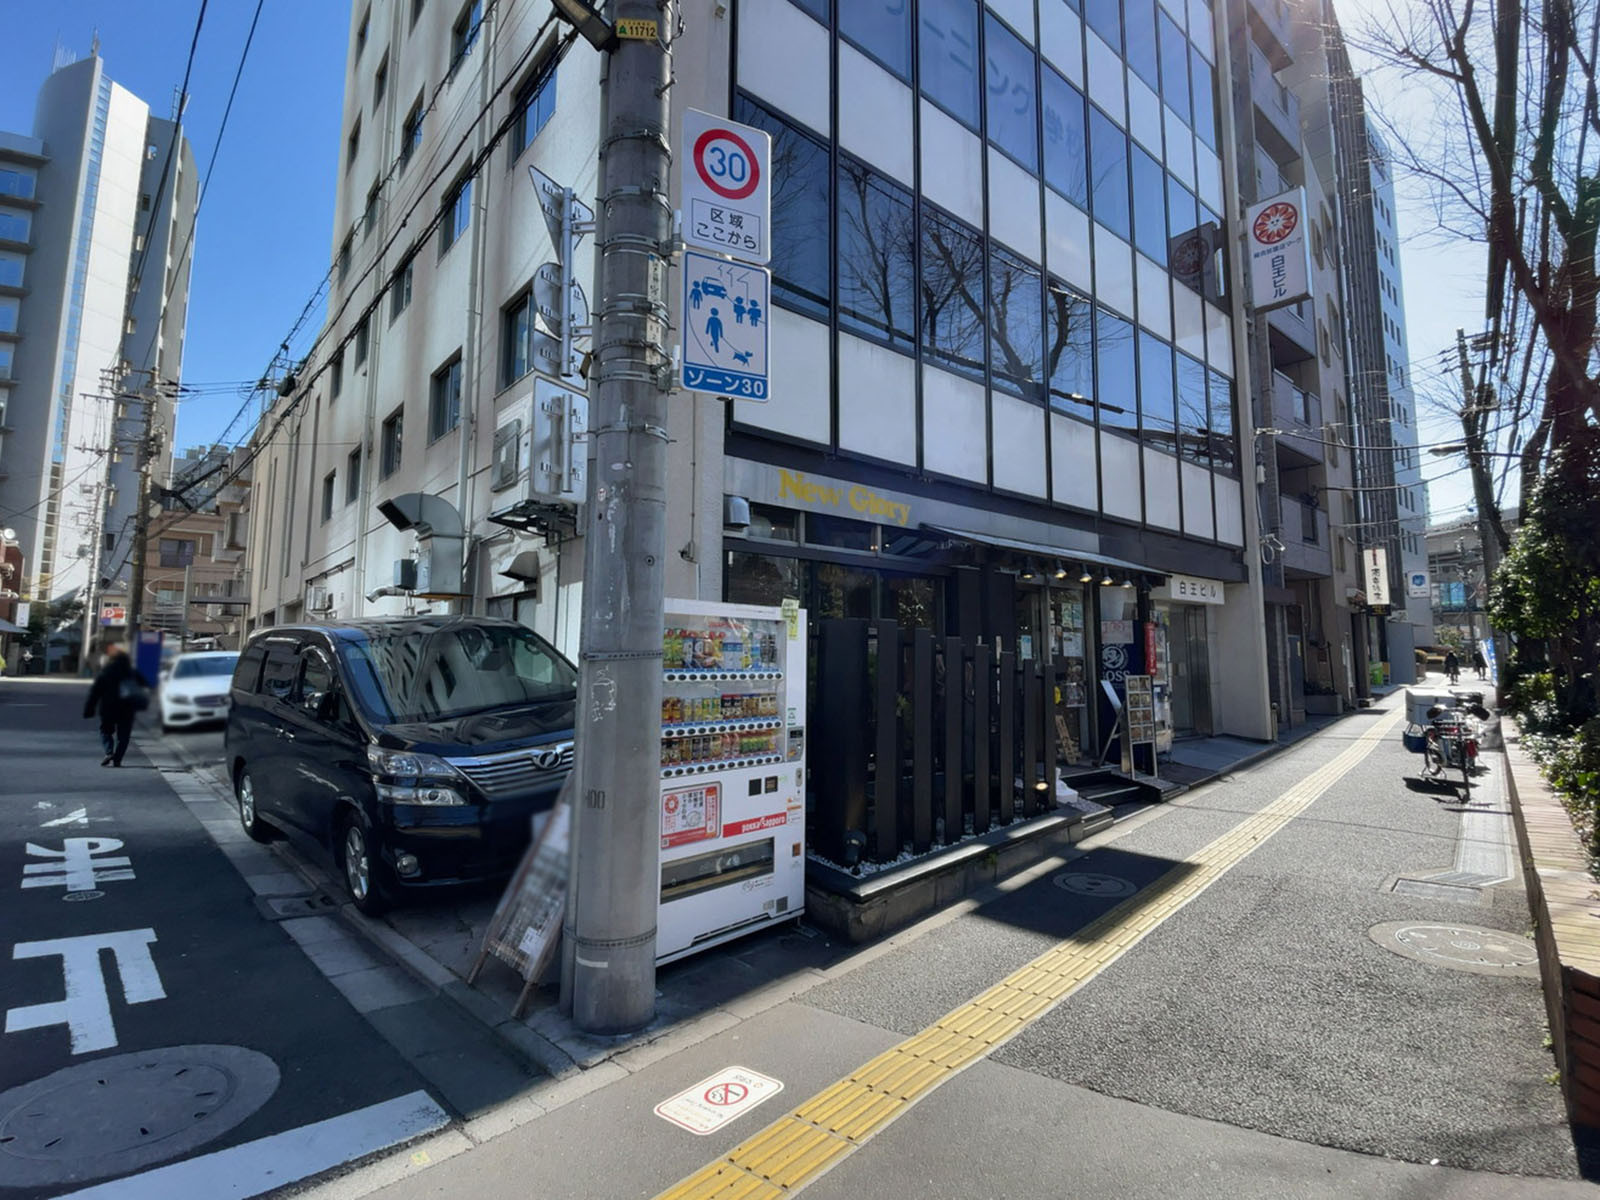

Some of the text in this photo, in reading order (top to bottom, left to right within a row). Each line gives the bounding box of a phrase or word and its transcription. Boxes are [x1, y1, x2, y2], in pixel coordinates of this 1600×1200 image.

[629, 25, 656, 37] 11712
[710, 147, 746, 182] 30
[710, 207, 744, 230] 区域
[696, 222, 757, 250] ここから
[1271, 254, 1288, 299] 白王ビル
[688, 370, 764, 396] ゾーン30
[778, 469, 911, 527] New Glory
[1179, 580, 1217, 599] 白王ビル
